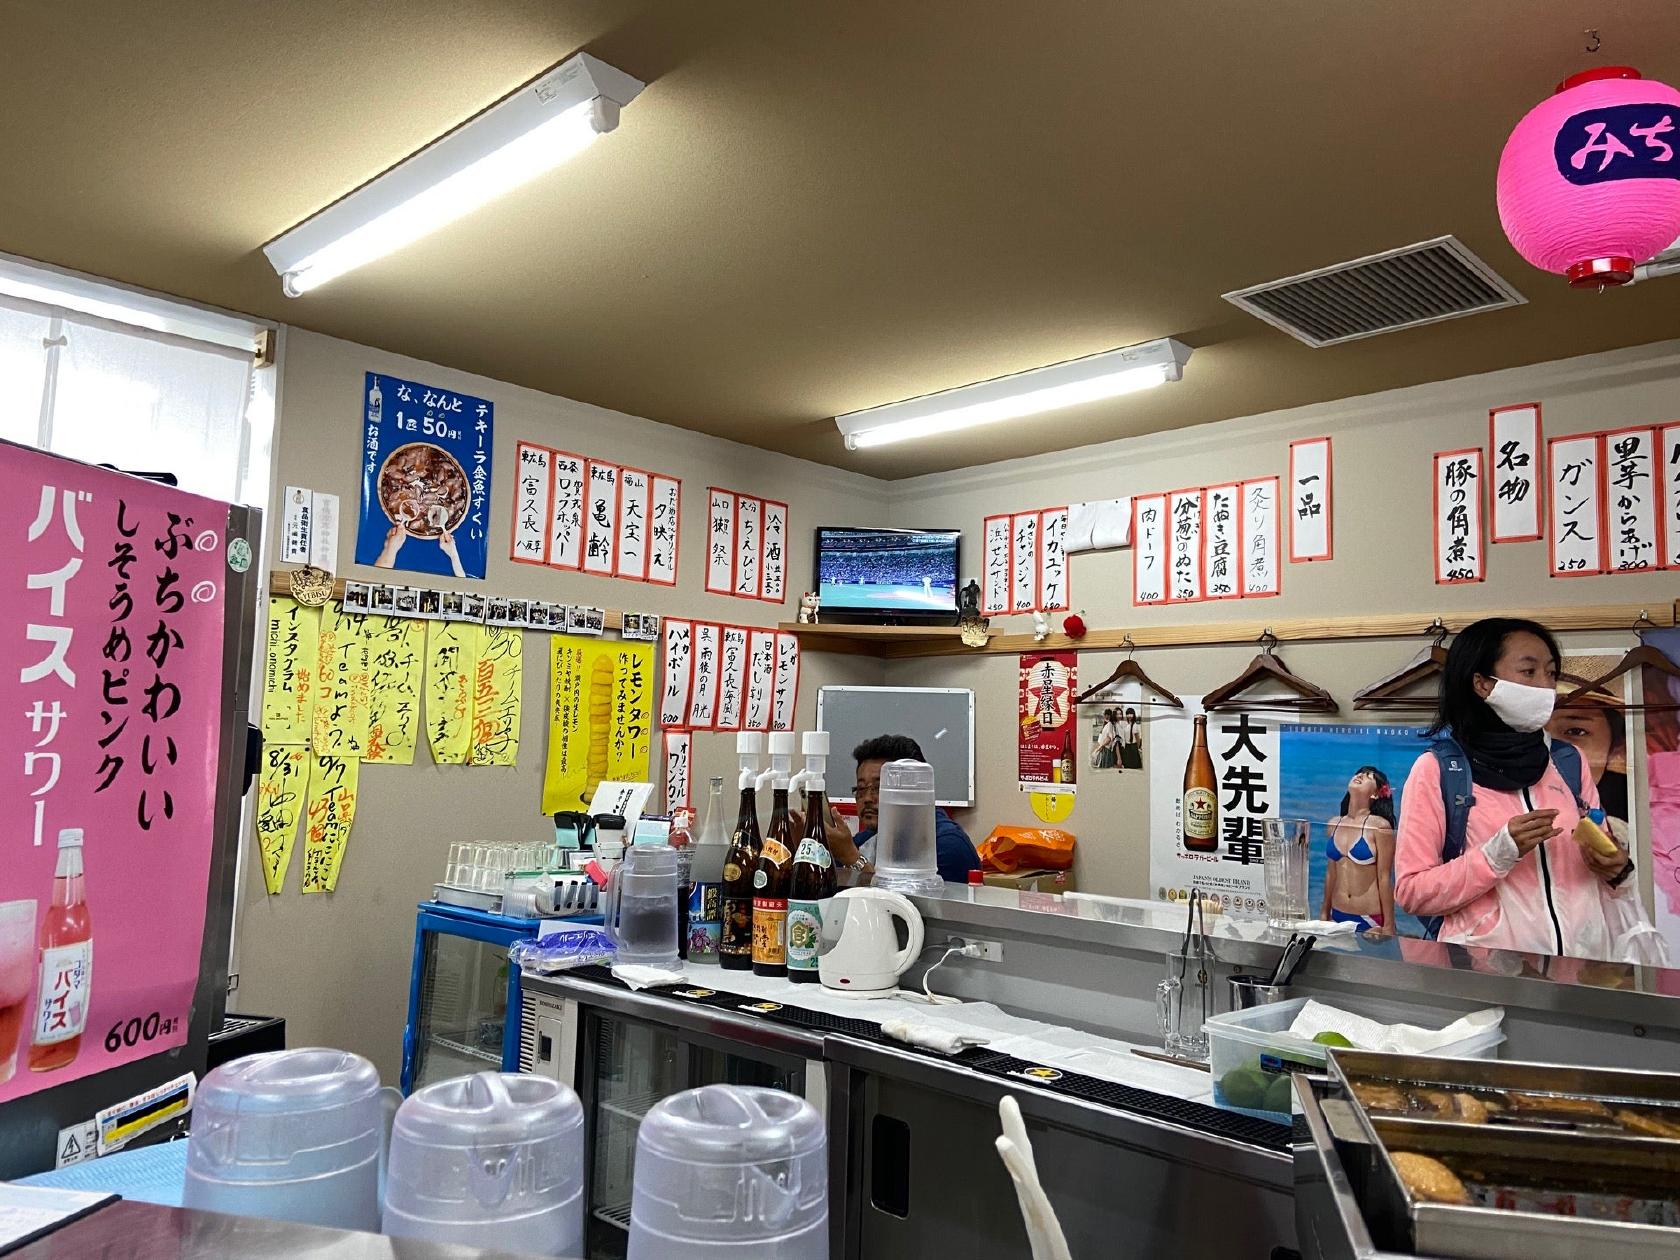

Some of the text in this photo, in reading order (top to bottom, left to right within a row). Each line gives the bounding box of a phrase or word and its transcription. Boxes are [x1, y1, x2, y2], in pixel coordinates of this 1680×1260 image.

[1570, 115, 1676, 174] みち
[397, 384, 463, 413] な、なんと
[366, 424, 380, 474] お酒です
[470, 404, 489, 540] テキーラ金魚すくい
[1496, 439, 1531, 505] 名物
[522, 475, 540, 533] 富久長
[712, 498, 729, 509] 山口
[740, 500, 757, 513] 大分
[1297, 474, 1322, 521] 一品
[1445, 458, 1478, 564] 豚の角煮
[1557, 457, 1596, 544] ガンス
[1611, 435, 1654, 561] 里芋からあげ
[623, 499, 643, 557] 天宝一
[653, 503, 669, 567] 夕映え
[712, 516, 730, 566] 獺祭
[739, 519, 756, 593] ちえびじん
[766, 514, 782, 561] 冷酒
[1027, 518, 1036, 559] あさりの
[1141, 508, 1157, 571] 肉ドーフ
[1210, 492, 1231, 578] たぬき豆腐
[1015, 528, 1029, 589] チャンジャ
[1045, 518, 1062, 601] イカユッケ
[1446, 568, 1475, 582] 450
[1557, 557, 1588, 571] 250
[1617, 559, 1649, 572] 300
[1016, 600, 1031, 610] 400
[1139, 591, 1159, 601] 400
[1175, 588, 1195, 599] 350
[1212, 583, 1232, 594] 350
[20, 485, 92, 846] バイスサワー
[94, 499, 140, 794] しそうめピンク
[282, 605, 301, 693] インスタグラム
[667, 629, 683, 697] ハイボール
[682, 628, 691, 655] メガ
[763, 641, 773, 675] 日本酒
[789, 641, 798, 666] メガ
[138, 512, 194, 830] ぶちかわいい
[698, 647, 713, 697] 雨後の月
[749, 651, 764, 718] だし割り
[775, 643, 789, 720] レモンサワー
[1040, 662, 1055, 725] 赤星縁日
[627, 653, 645, 760] レモンタワー
[662, 714, 679, 724] 800
[676, 741, 689, 799] オリジナル
[1221, 713, 1270, 866] 大先輩
[51, 968, 73, 1031] バイス
[104, 1012, 172, 1053] 600円
